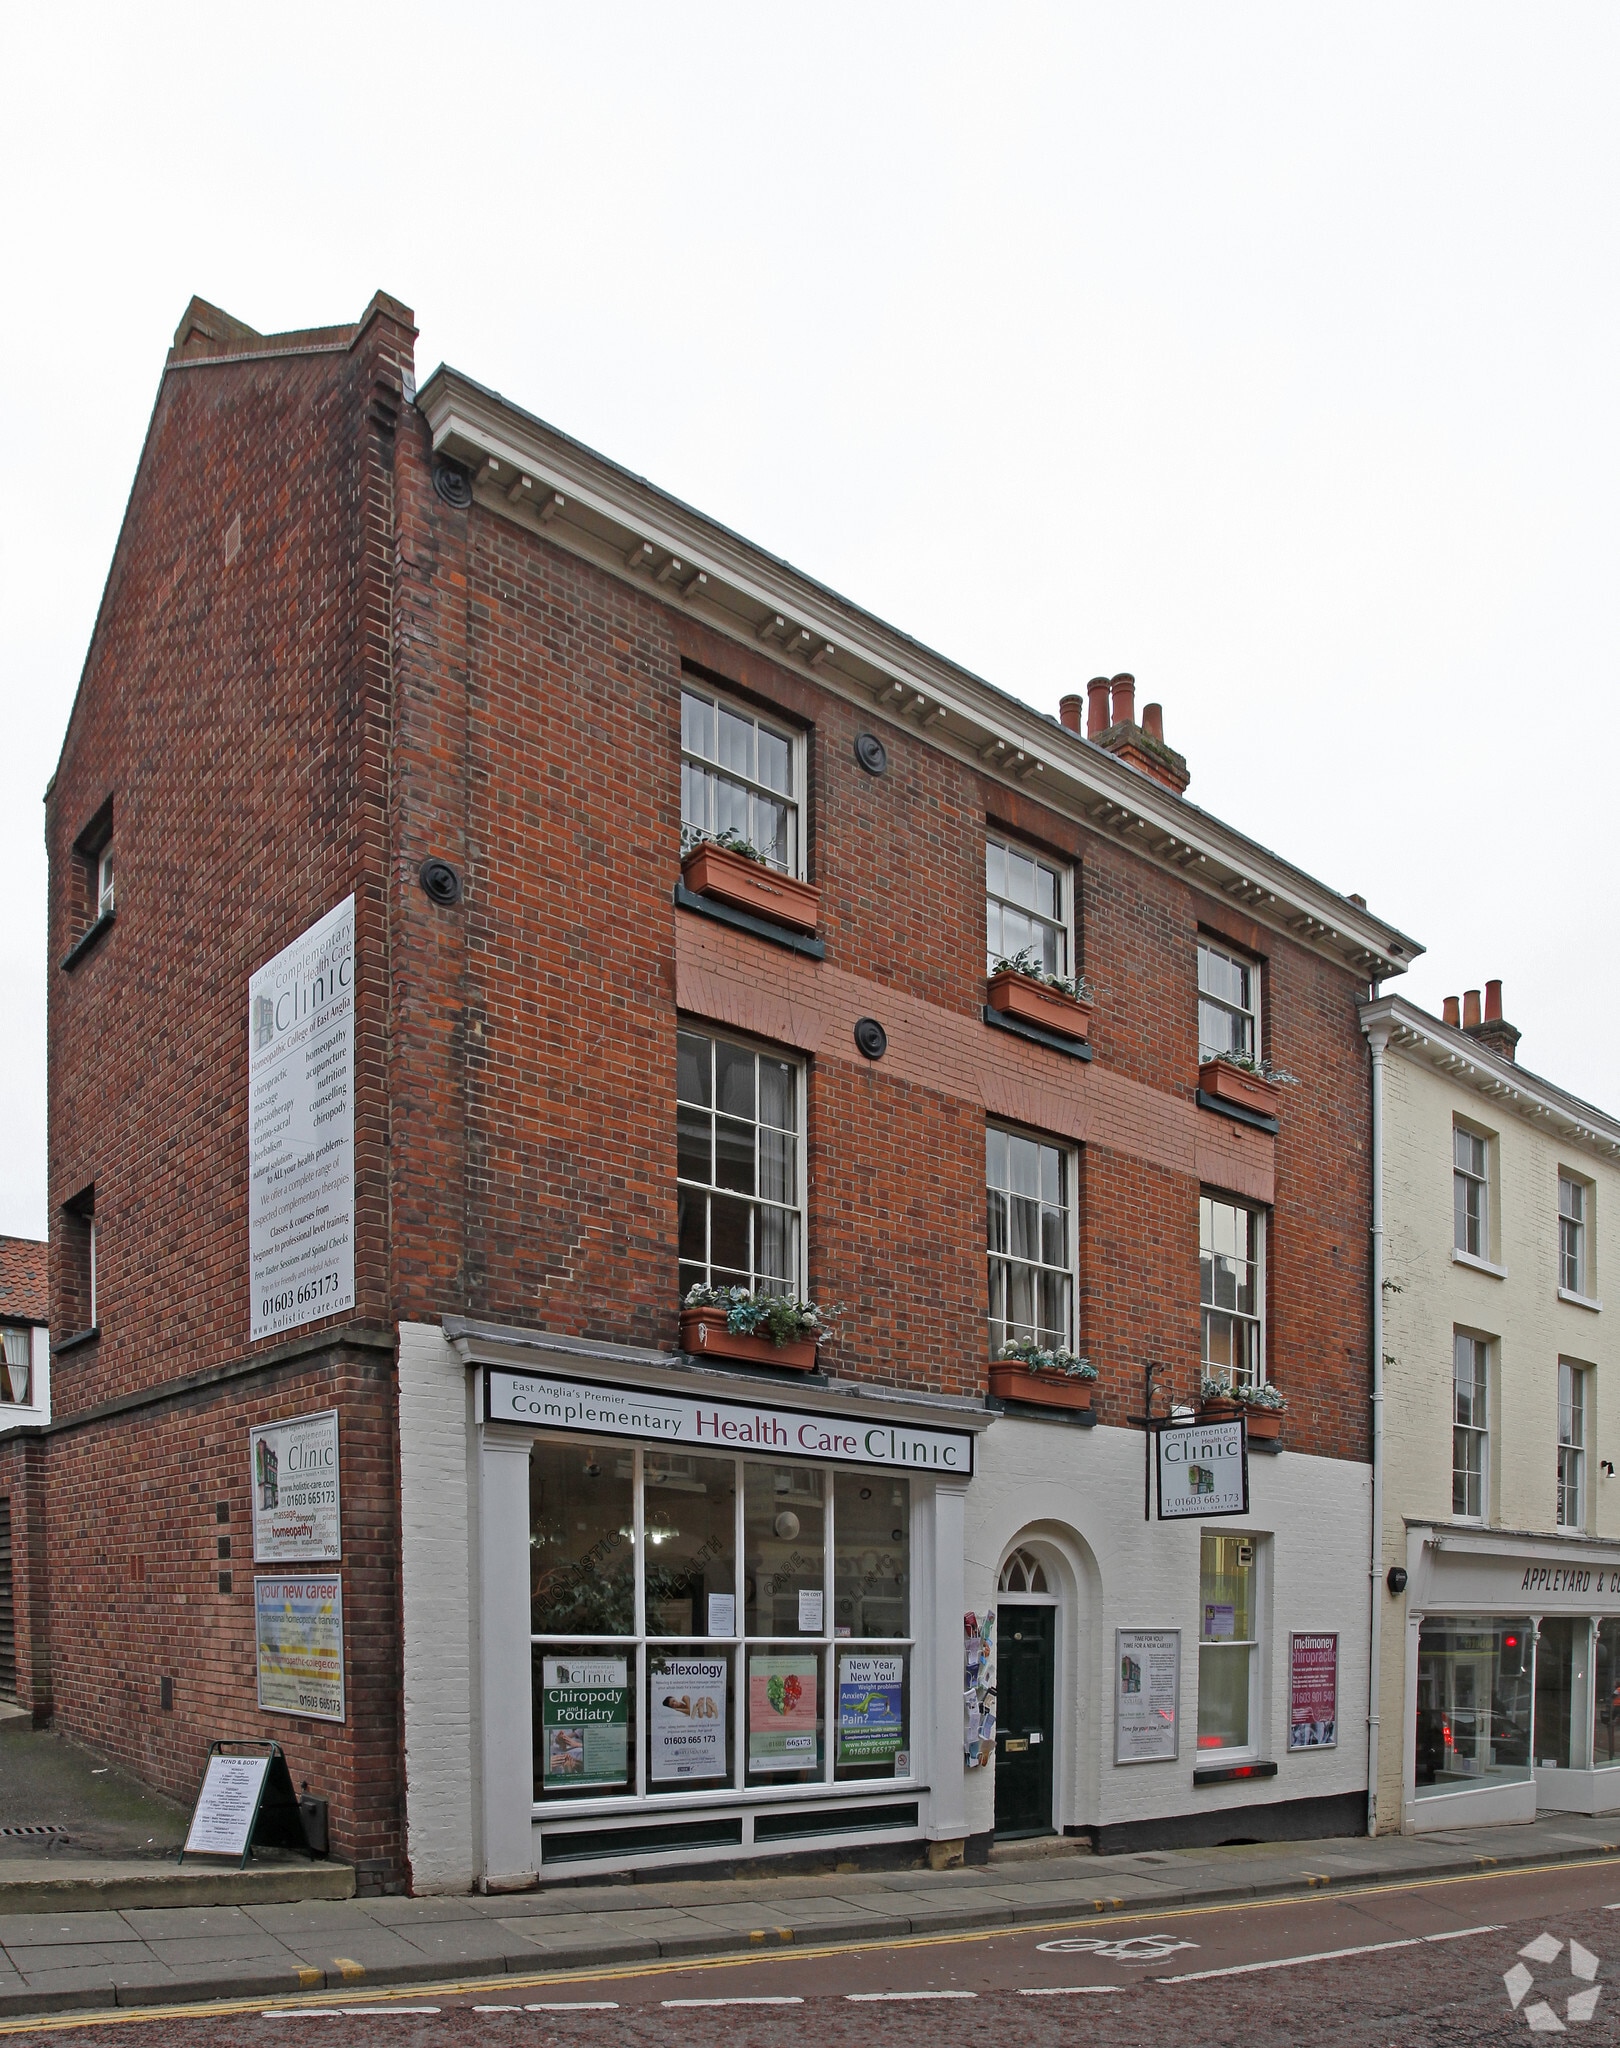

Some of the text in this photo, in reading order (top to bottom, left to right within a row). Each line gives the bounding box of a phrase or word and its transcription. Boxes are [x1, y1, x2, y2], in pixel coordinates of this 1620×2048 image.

[276, 923, 352, 989] Complementary
[289, 936, 314, 957] Premier
[303, 941, 352, 985] Health Care
[276, 957, 352, 1031] Clinic
[251, 997, 351, 1073] Homeopathic College of East Anglia
[305, 1030, 347, 1063] homeopathy
[306, 1048, 347, 1080] acupuncture
[254, 1068, 287, 1097] chiropractic
[317, 1066, 347, 1090] nutrition
[254, 1092, 279, 1113] massage
[309, 1083, 347, 1112] counselling
[254, 1098, 294, 1132] physiotherapy
[313, 1100, 347, 1127] chiropody
[254, 1113, 290, 1146] cranio-sacral
[254, 1139, 283, 1162] herbalism
[267, 1137, 350, 1185] to ALL your health problems...
[253, 1152, 293, 1180] natural solutions
[260, 1193, 270, 1206] We
[270, 1186, 283, 1201] offer
[288, 1171, 315, 1191] complete
[315, 1163, 331, 1178] range
[332, 1154, 340, 1169] of
[253, 1173, 350, 1228] respected complementary therapies
[269, 1204, 330, 1237] Classes & courses from
[253, 1212, 349, 1263] beginner to professional level training
[254, 1270, 265, 1281] Free
[280, 1255, 300, 1270] Sessions
[301, 1247, 312, 1261] and
[311, 1240, 328, 1258] Spinal
[328, 1233, 349, 1249] Checks
[280, 1271, 297, 1287] Friendly
[297, 1267, 306, 1279] and
[306, 1261, 324, 1276] Helpful
[323, 1256, 340, 1269] Advice
[262, 1272, 339, 1317] 01603 665173
[512, 1381, 625, 1405] East Anglia's Premier
[290, 1429, 332, 1443] Complementary
[511, 1395, 957, 1466] Complementary Health Care Clinic
[1165, 1427, 1238, 1440] Complementary
[306, 1439, 334, 1450] Health Care
[1165, 1440, 1238, 1462] Clinic
[289, 1443, 334, 1471] Clinic
[280, 1480, 335, 1493] www.holistic-care.com
[286, 1490, 336, 1507] 01603 665173
[1165, 1493, 1239, 1507] T. 01603 665 173
[274, 1510, 296, 1521] massage
[295, 1513, 316, 1523] chiropody
[271, 1523, 313, 1540] homeopathy
[536, 1530, 621, 1615] HOLISTIC
[660, 1535, 723, 1606] HEALTH
[764, 1551, 805, 1597] CARE
[1521, 1567, 1591, 1592] APPLEYARD
[1596, 1571, 1605, 1592] &
[260, 1584, 338, 1603] your new career
[840, 1554, 893, 1613] CLINIC
[285, 1613, 317, 1626] homeopathic
[318, 1615, 340, 1628] training
[849, 1660, 896, 1670] New Year,
[1292, 1649, 1336, 1666] chiropractic
[571, 1670, 615, 1684] Clinic
[656, 1662, 723, 1678] eflexology
[850, 1671, 895, 1682] New You!
[299, 1694, 318, 1708] 01603
[319, 1697, 341, 1712] 665173
[549, 1690, 622, 1704] Chiropody
[841, 1692, 869, 1700] Anxiety?
[1292, 1692, 1311, 1704] 01603
[1312, 1691, 1322, 1702] 901
[557, 1708, 615, 1722] Podiatry
[842, 1713, 869, 1725] Pain?
[688, 1735, 701, 1743] 665
[845, 1739, 901, 1748] www.holistic-care.com
[849, 1745, 896, 1756] 01603 665173
